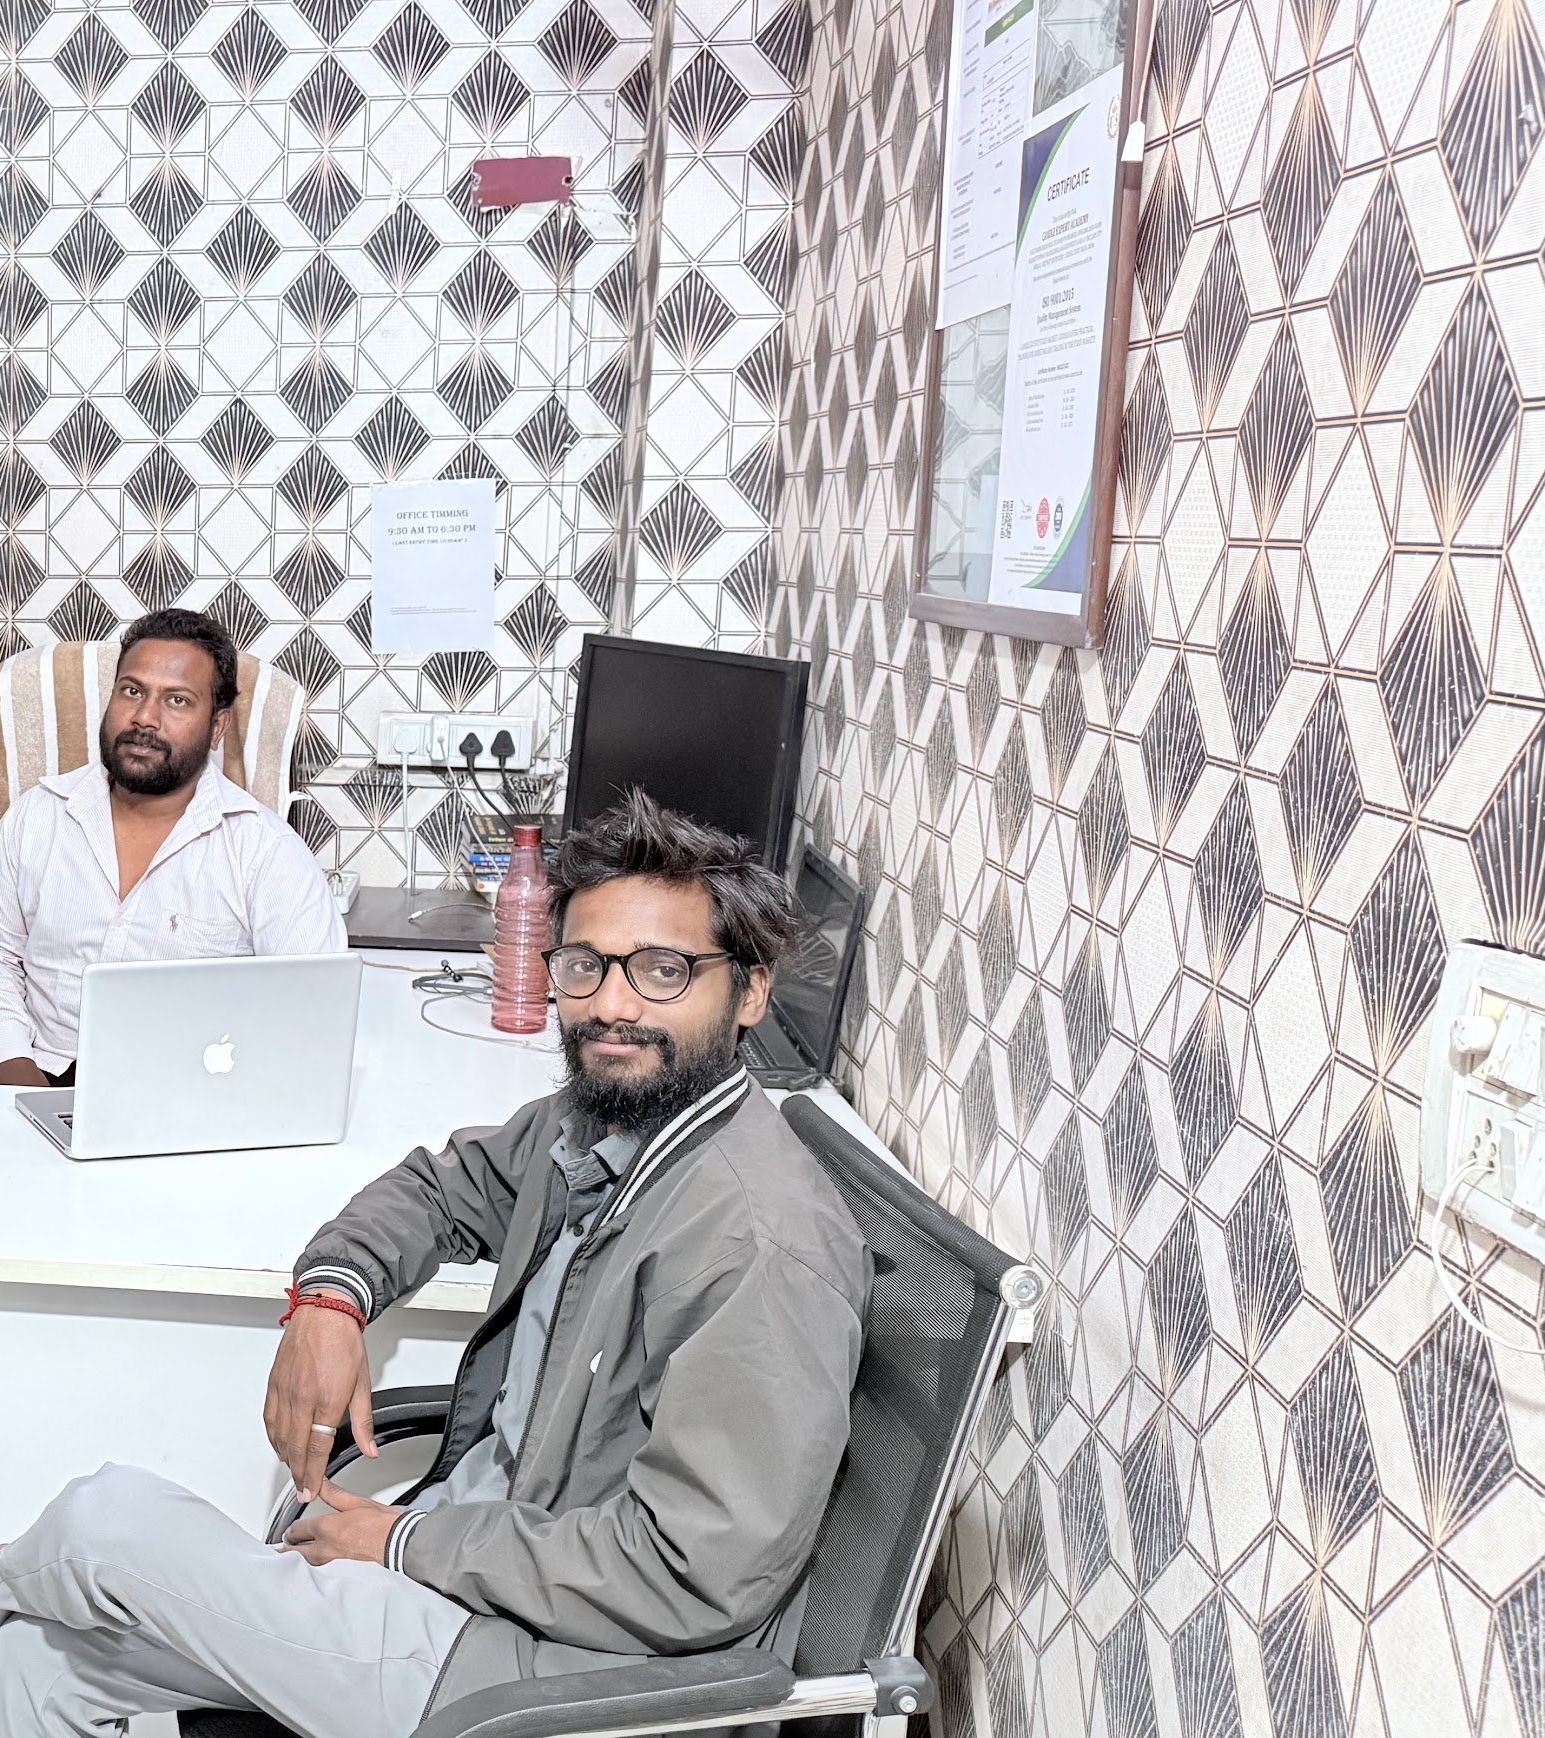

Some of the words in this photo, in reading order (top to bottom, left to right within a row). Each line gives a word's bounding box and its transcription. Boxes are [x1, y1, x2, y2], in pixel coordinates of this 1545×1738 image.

[1047, 167, 1090, 201] CERTIFICATE
[1042, 296, 1050, 308] ISO
[1050, 288, 1074, 306] 9001:2015
[396, 511, 428, 520] OFFICE
[430, 509, 469, 518] TIMMING
[387, 526, 408, 536] 9:30
[410, 526, 424, 535] AM
[426, 525, 438, 534] TO
[440, 524, 461, 533] 6:30
[463, 523, 476, 532] PM
